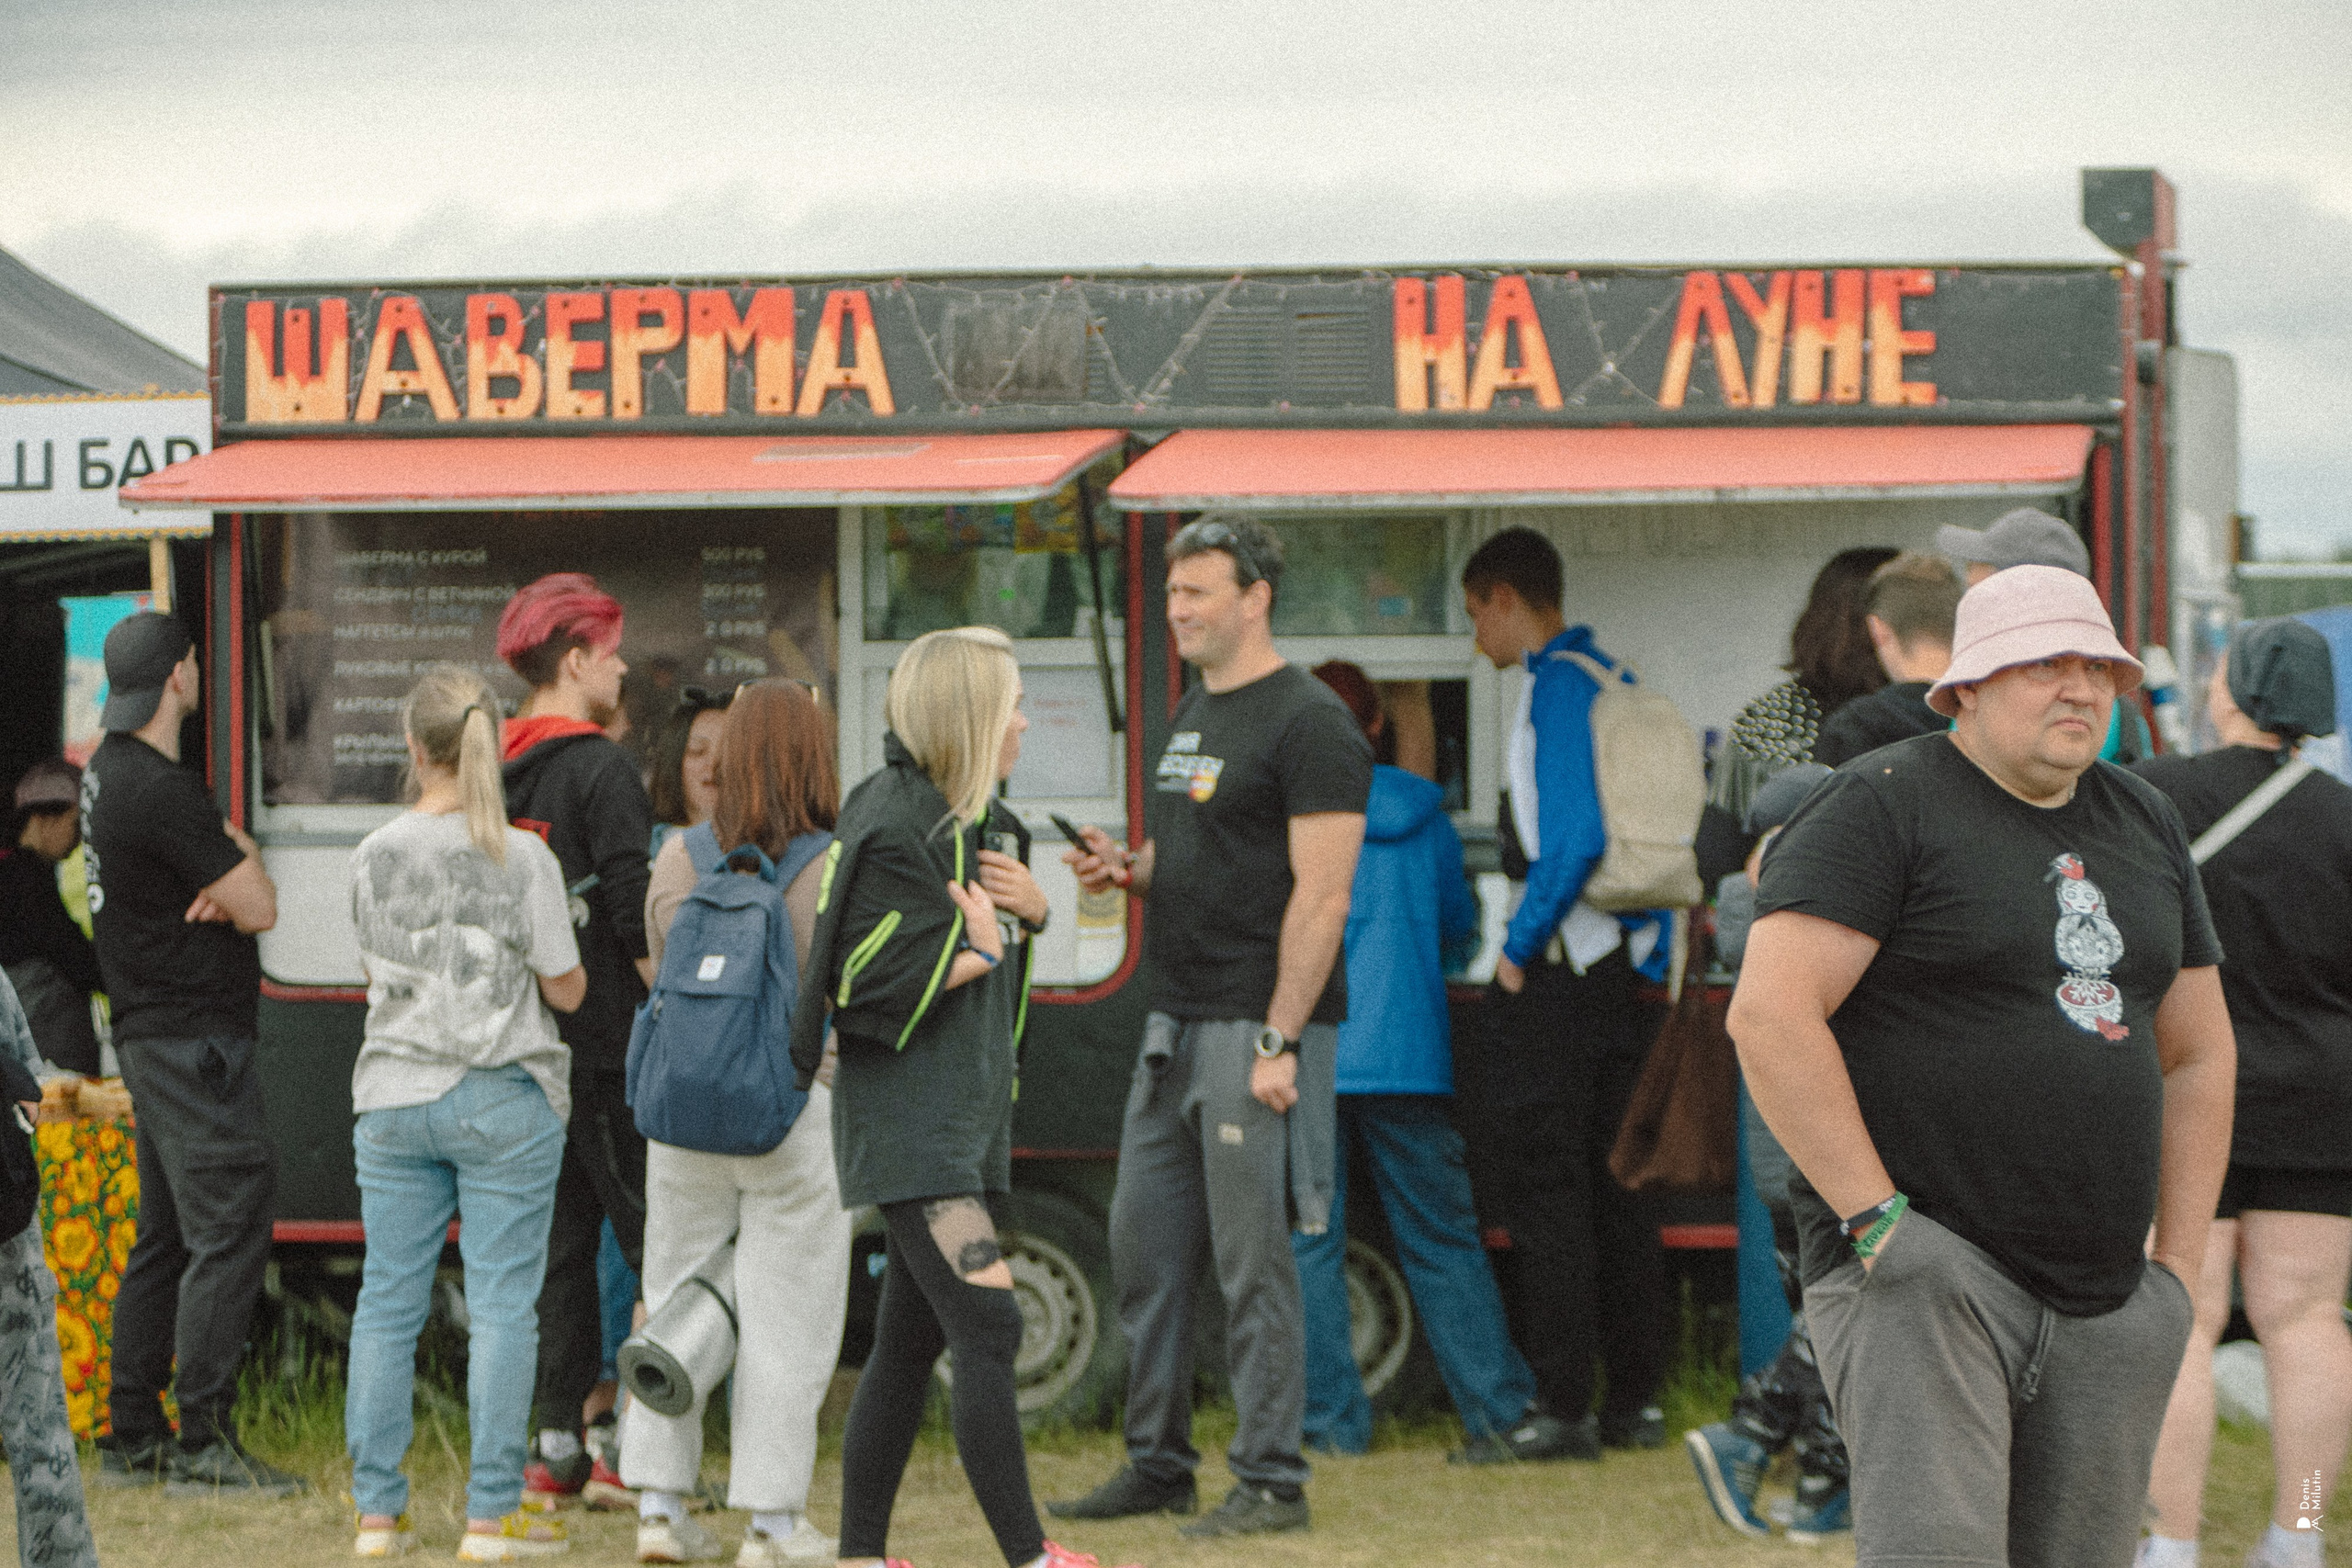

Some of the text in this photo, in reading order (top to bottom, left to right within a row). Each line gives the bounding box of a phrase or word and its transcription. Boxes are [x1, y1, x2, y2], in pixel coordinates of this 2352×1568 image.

[244, 269, 1937, 423] ШАВЕРМА НА ЛУНЕ
